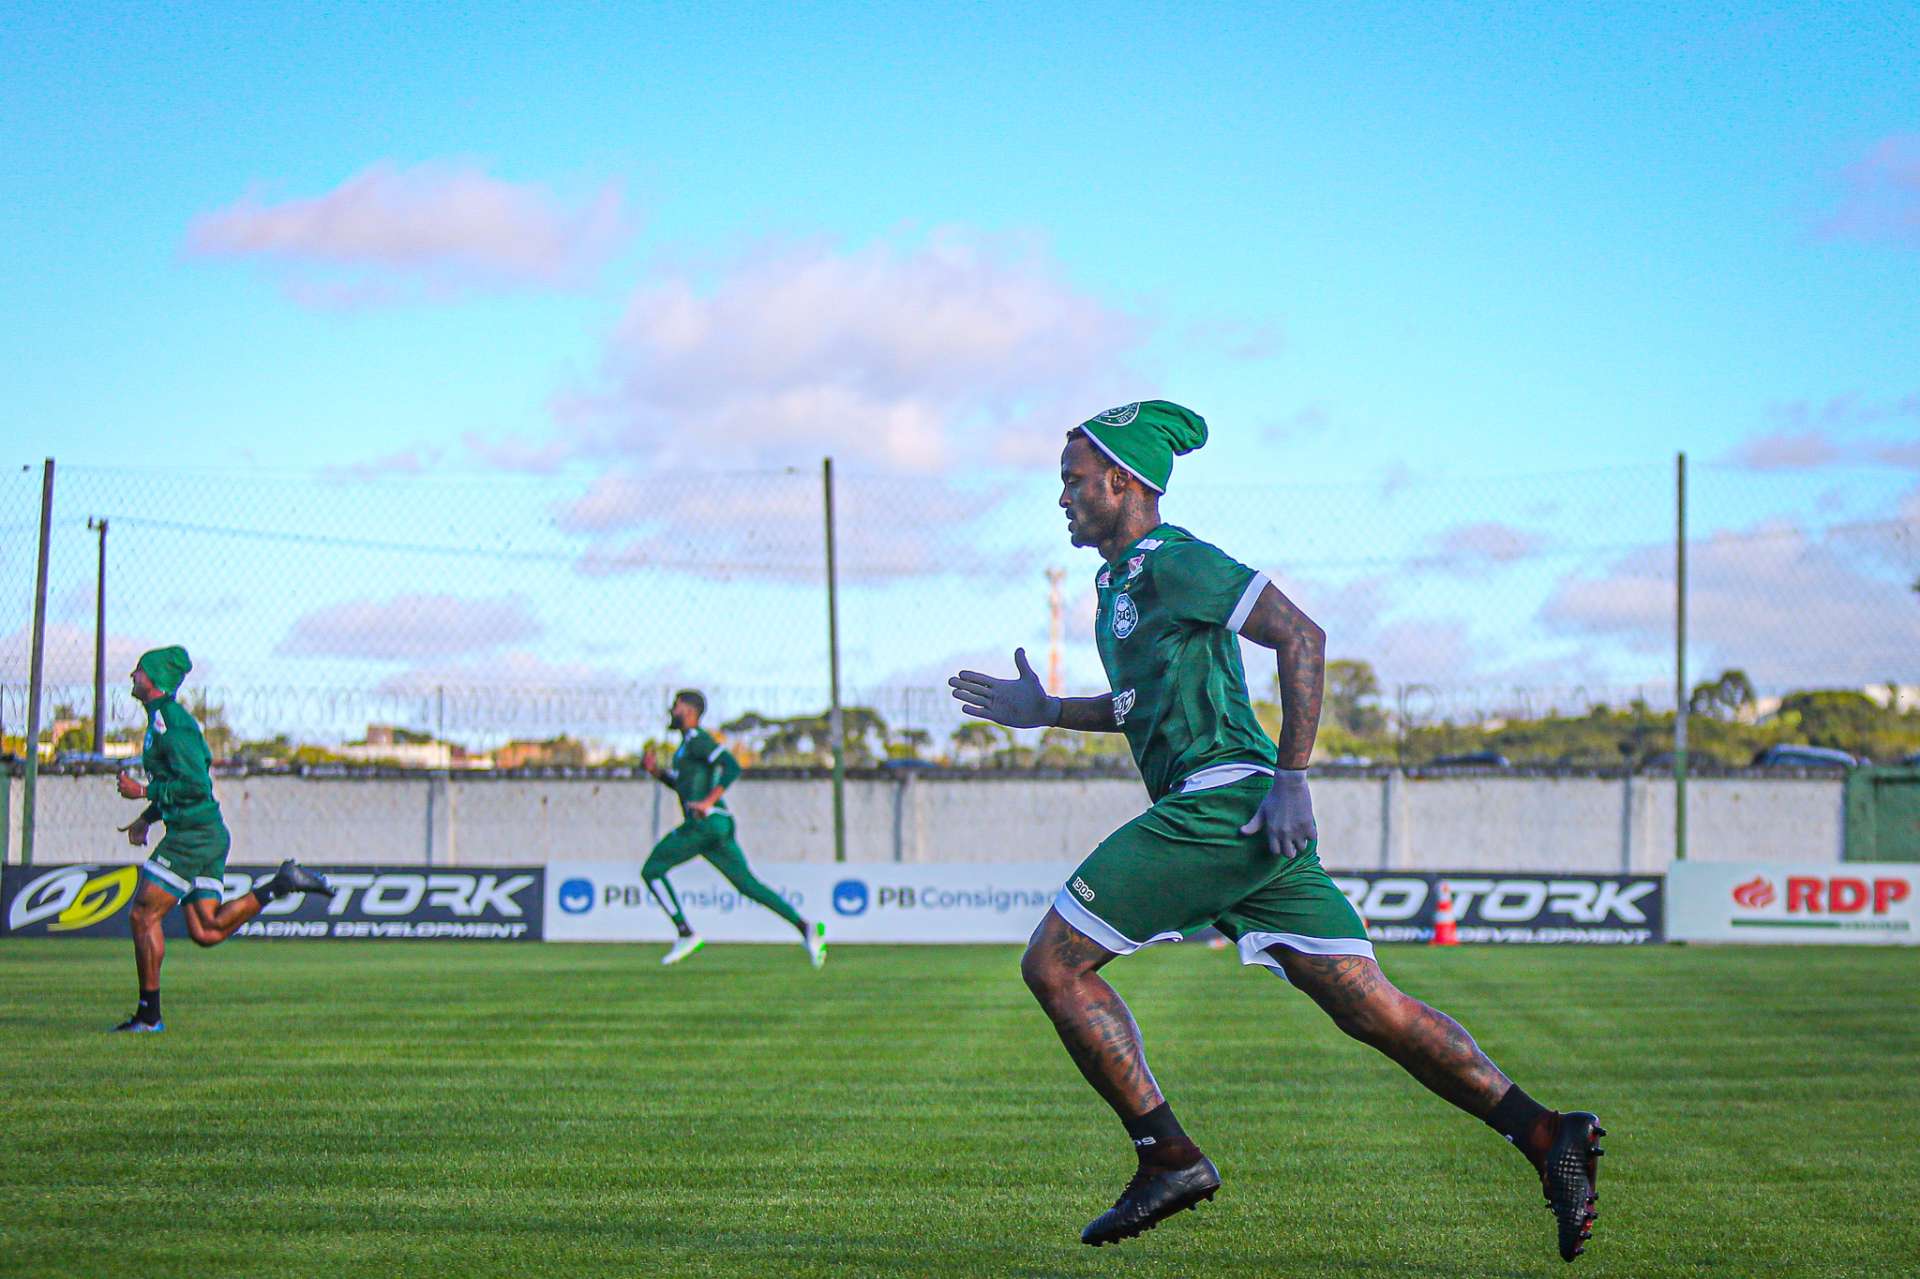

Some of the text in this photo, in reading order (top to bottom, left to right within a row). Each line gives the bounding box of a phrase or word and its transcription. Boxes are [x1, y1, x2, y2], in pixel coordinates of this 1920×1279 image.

[322, 874, 535, 916] TORK
[604, 885, 641, 906] PB
[877, 886, 916, 908] PB
[1072, 876, 1095, 902] 1909
[1438, 878, 1657, 923] TORK
[1786, 875, 1912, 914] RDP
[334, 921, 528, 938] DEVELOPMENT
